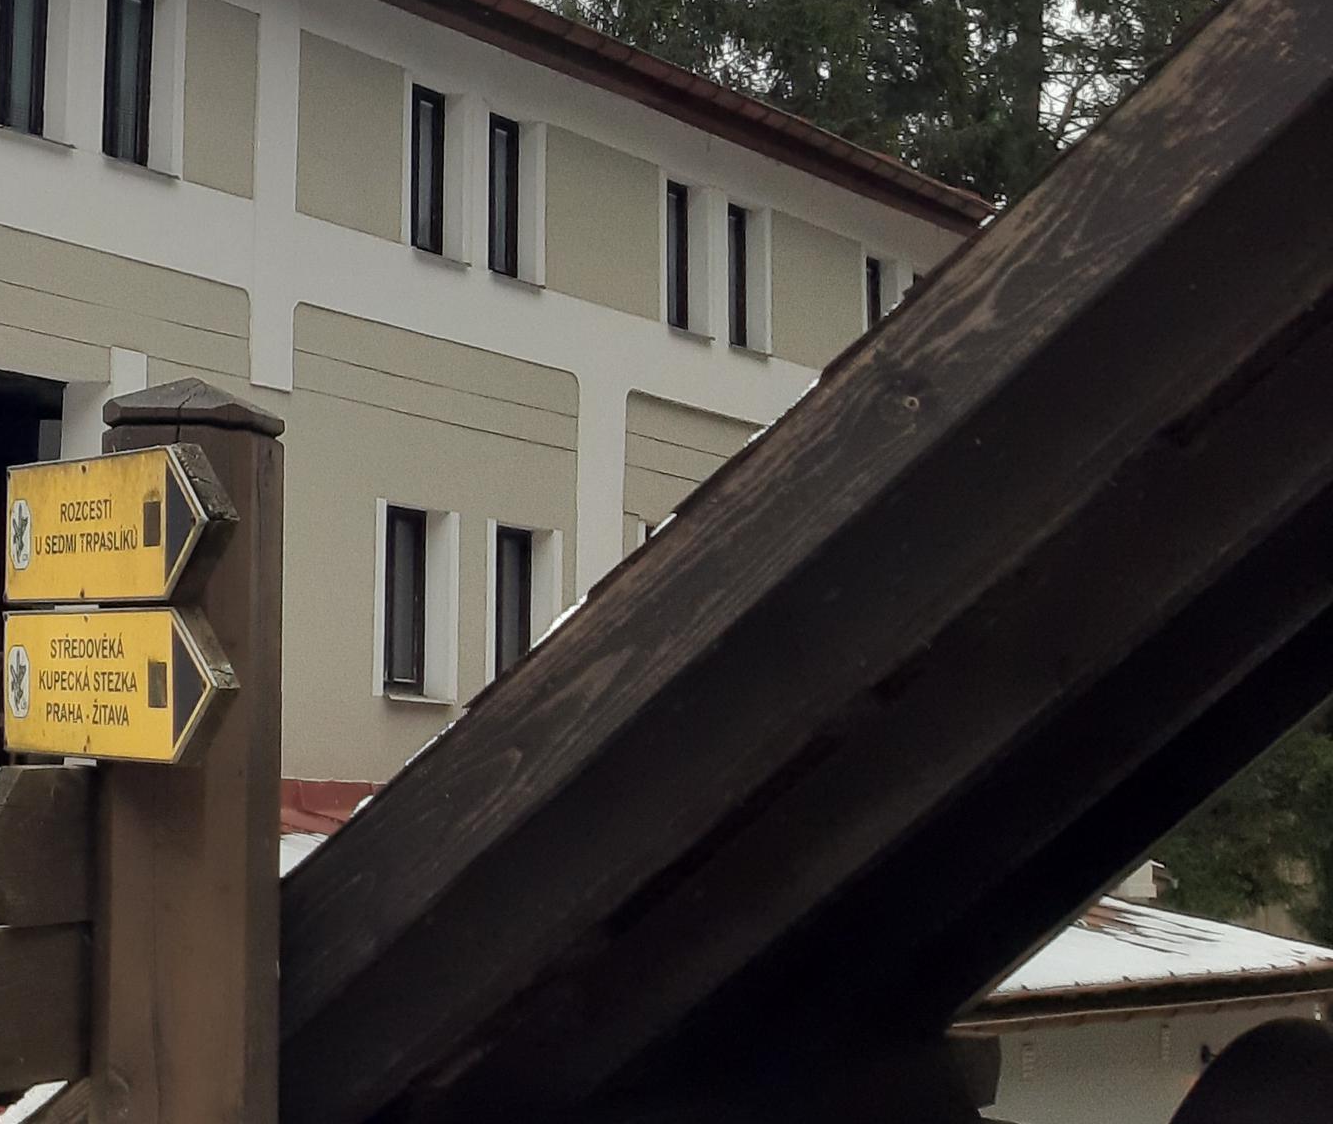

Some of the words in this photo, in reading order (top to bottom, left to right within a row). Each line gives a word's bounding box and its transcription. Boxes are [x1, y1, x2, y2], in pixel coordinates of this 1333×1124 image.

[35, 535, 42, 556] U
[44, 532, 77, 556] SEDMI
[38, 665, 90, 692] KUPECKÁ
[92, 670, 138, 693] STEZKA
[45, 702, 83, 724] PRAHA
[92, 699, 130, 726] ŽITAVA
